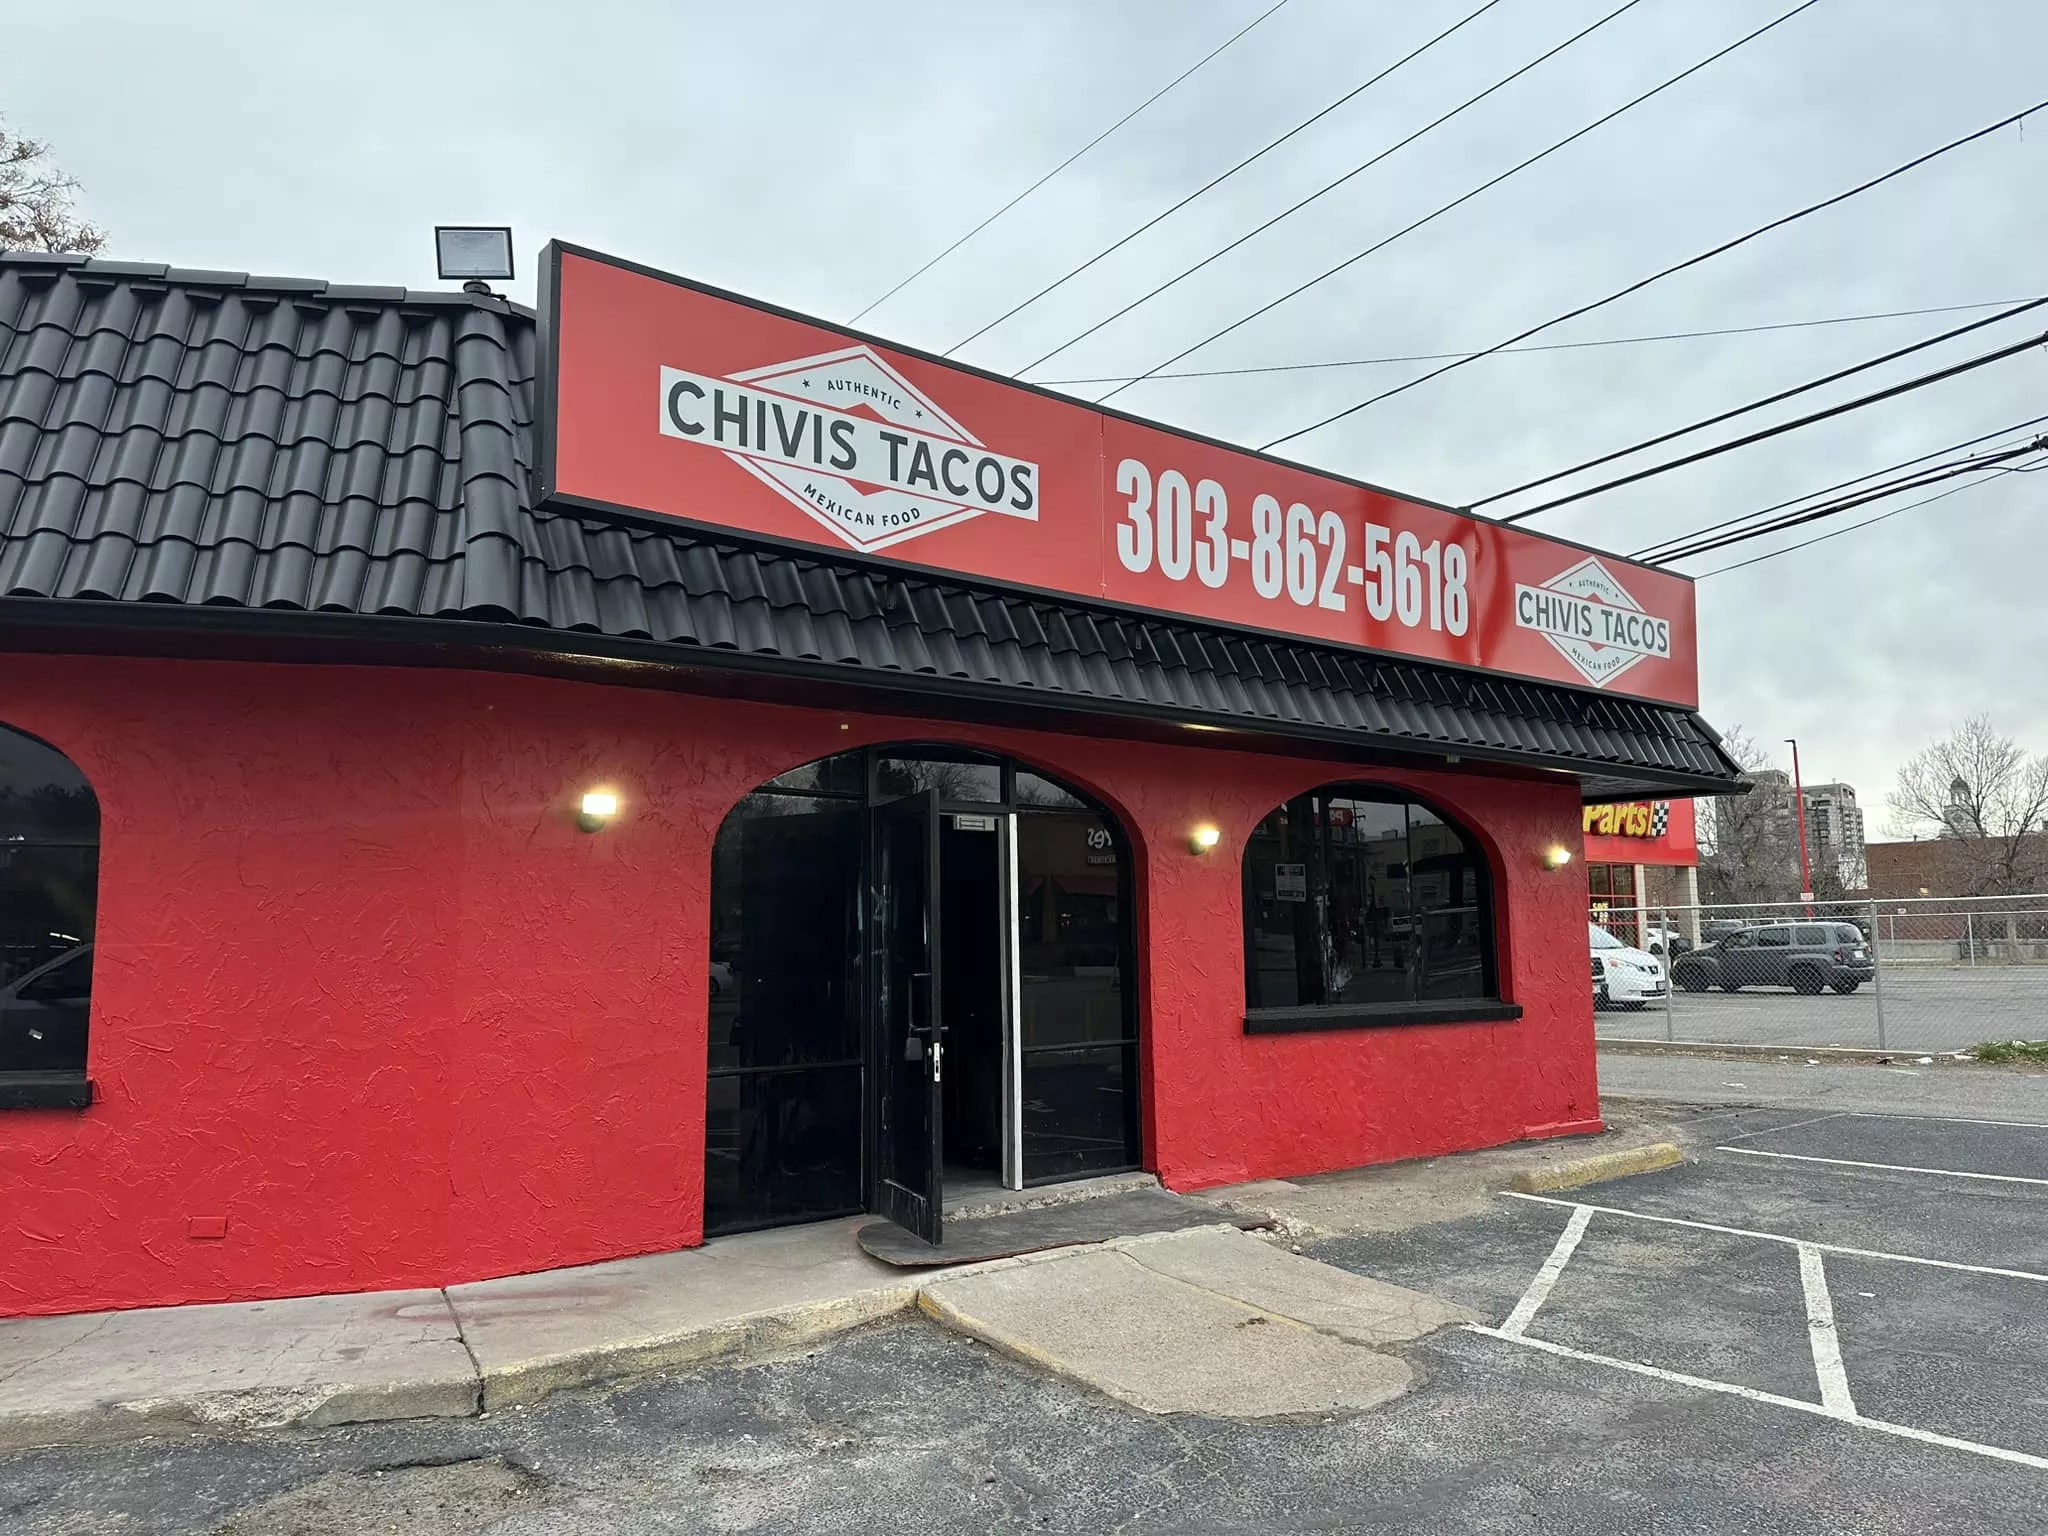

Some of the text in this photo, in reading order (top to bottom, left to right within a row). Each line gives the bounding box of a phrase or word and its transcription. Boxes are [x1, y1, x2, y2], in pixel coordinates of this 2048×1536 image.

[827, 379, 901, 410] AUTHENTIC
[667, 380, 1034, 511] CHIVIS TACOS
[803, 483, 921, 527] MEXICAN FOOD
[1116, 458, 1469, 637] 303-862-5618
[1578, 579, 1609, 594] AUTHENTIC
[1518, 591, 1668, 653] CHIVIS TACOS
[1571, 647, 1621, 670] MEXICAN FOOD
[1582, 803, 1649, 835] Parts
